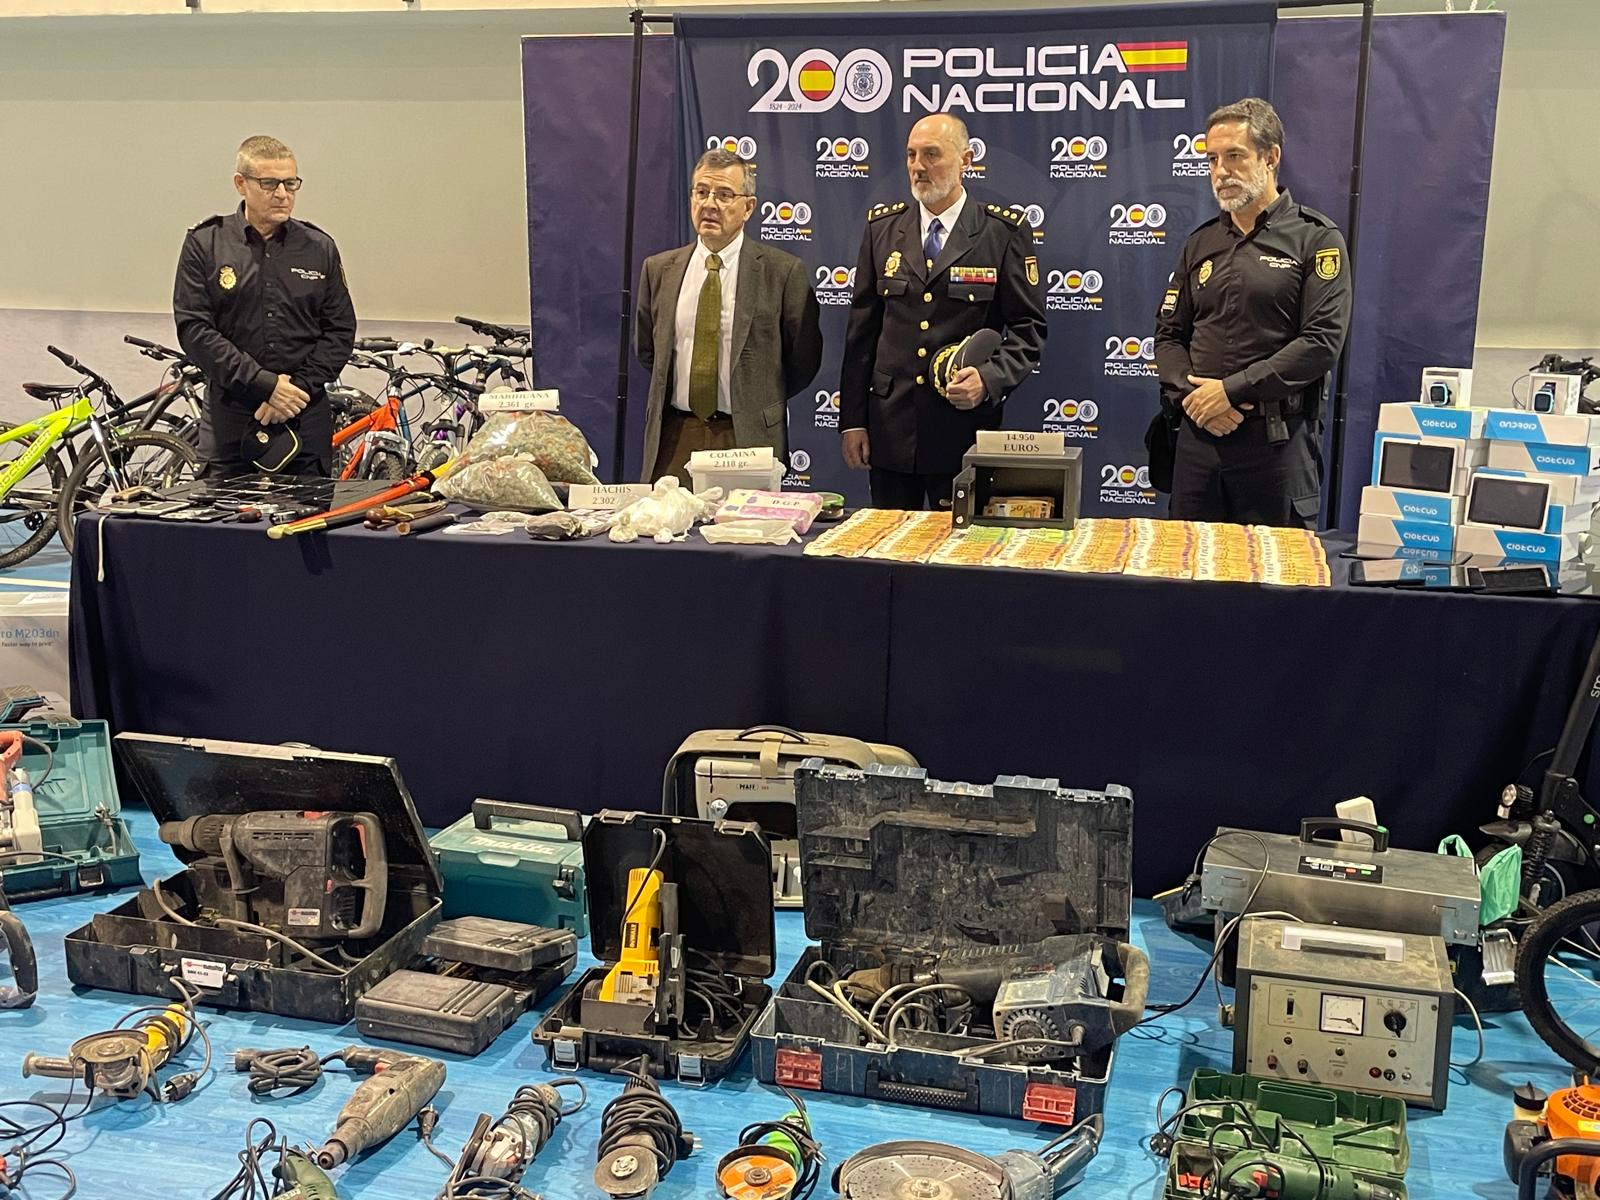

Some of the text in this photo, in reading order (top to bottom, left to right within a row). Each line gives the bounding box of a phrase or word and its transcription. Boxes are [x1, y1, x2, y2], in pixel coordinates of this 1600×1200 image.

[748, 48, 892, 113] 200
[903, 79, 1186, 113] NACIONAL
[815, 136, 869, 162] 200
[1050, 136, 1108, 162] 200
[1173, 133, 1208, 160] 20
[1172, 162, 1209, 170] POLIC
[760, 201, 812, 225] 200
[1109, 203, 1167, 228] 200
[1047, 269, 1103, 294] 200
[1046, 303, 1103, 311] NACIONAL
[1104, 369, 1160, 377] NACIONAL
[815, 389, 841, 413] 20
[1043, 398, 1099, 423] 200
[1003, 444, 1040, 453] EUROS
[1006, 433, 1035, 442] 14.950
[592, 485, 632, 494] HACHIS
[592, 496, 616, 505] 2.302
[1099, 496, 1156, 505] NACIONAL
[15, 628, 60, 640] M203dn
